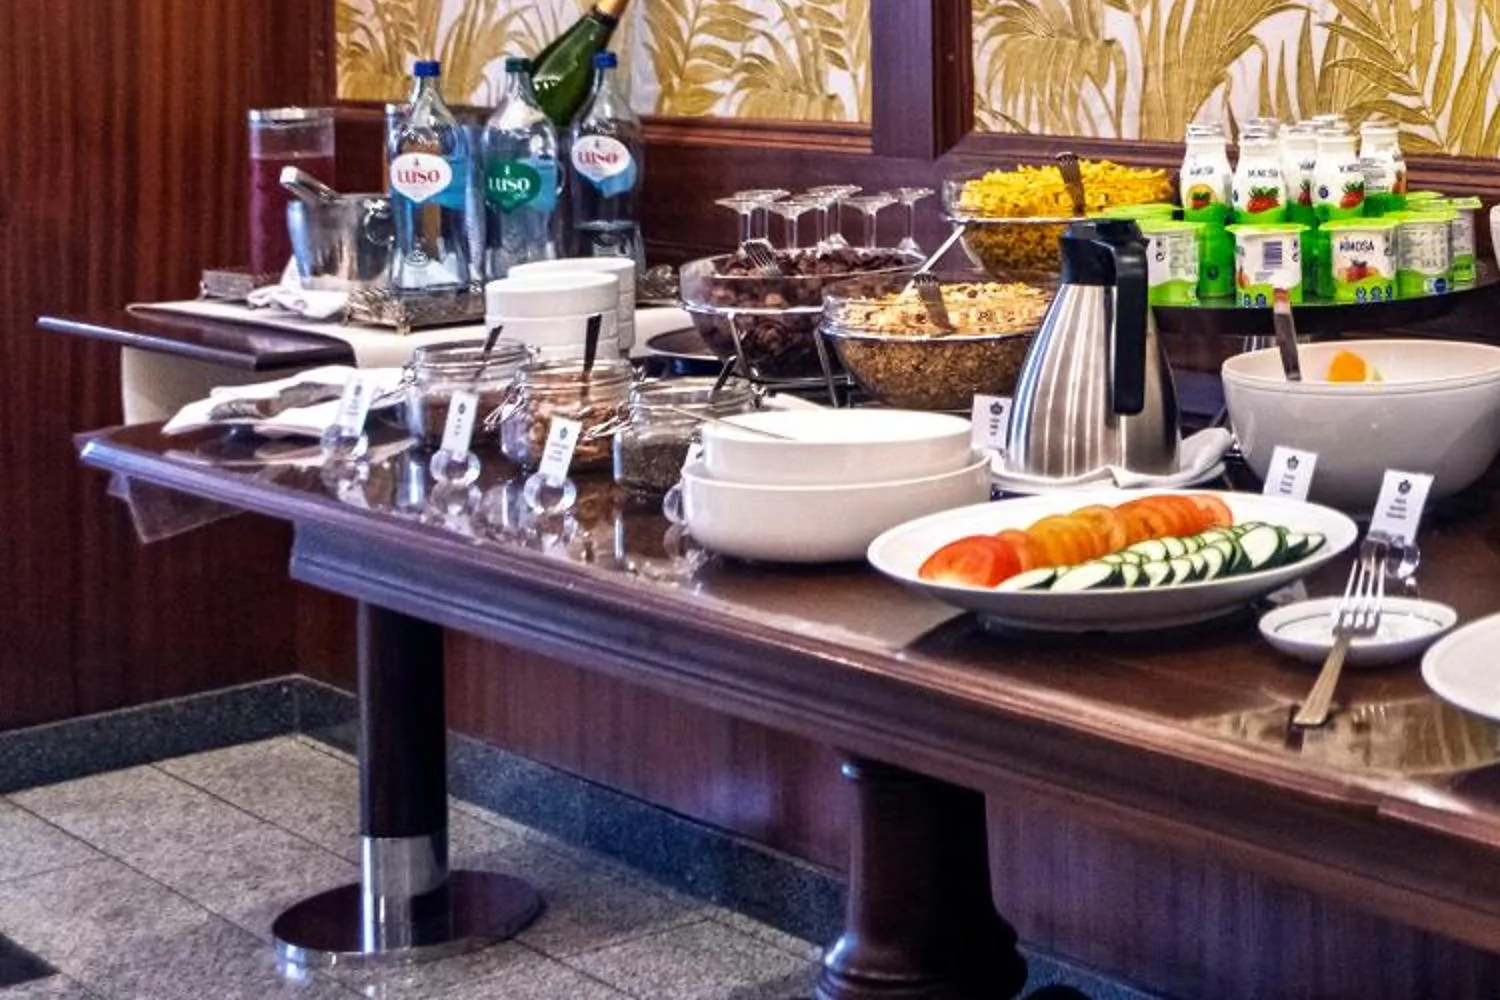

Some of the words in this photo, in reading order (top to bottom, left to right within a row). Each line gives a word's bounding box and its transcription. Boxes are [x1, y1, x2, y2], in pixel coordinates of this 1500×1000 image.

[577, 151, 619, 165] LUSO
[397, 169, 440, 185] LUSO
[489, 176, 531, 192] LUSO
